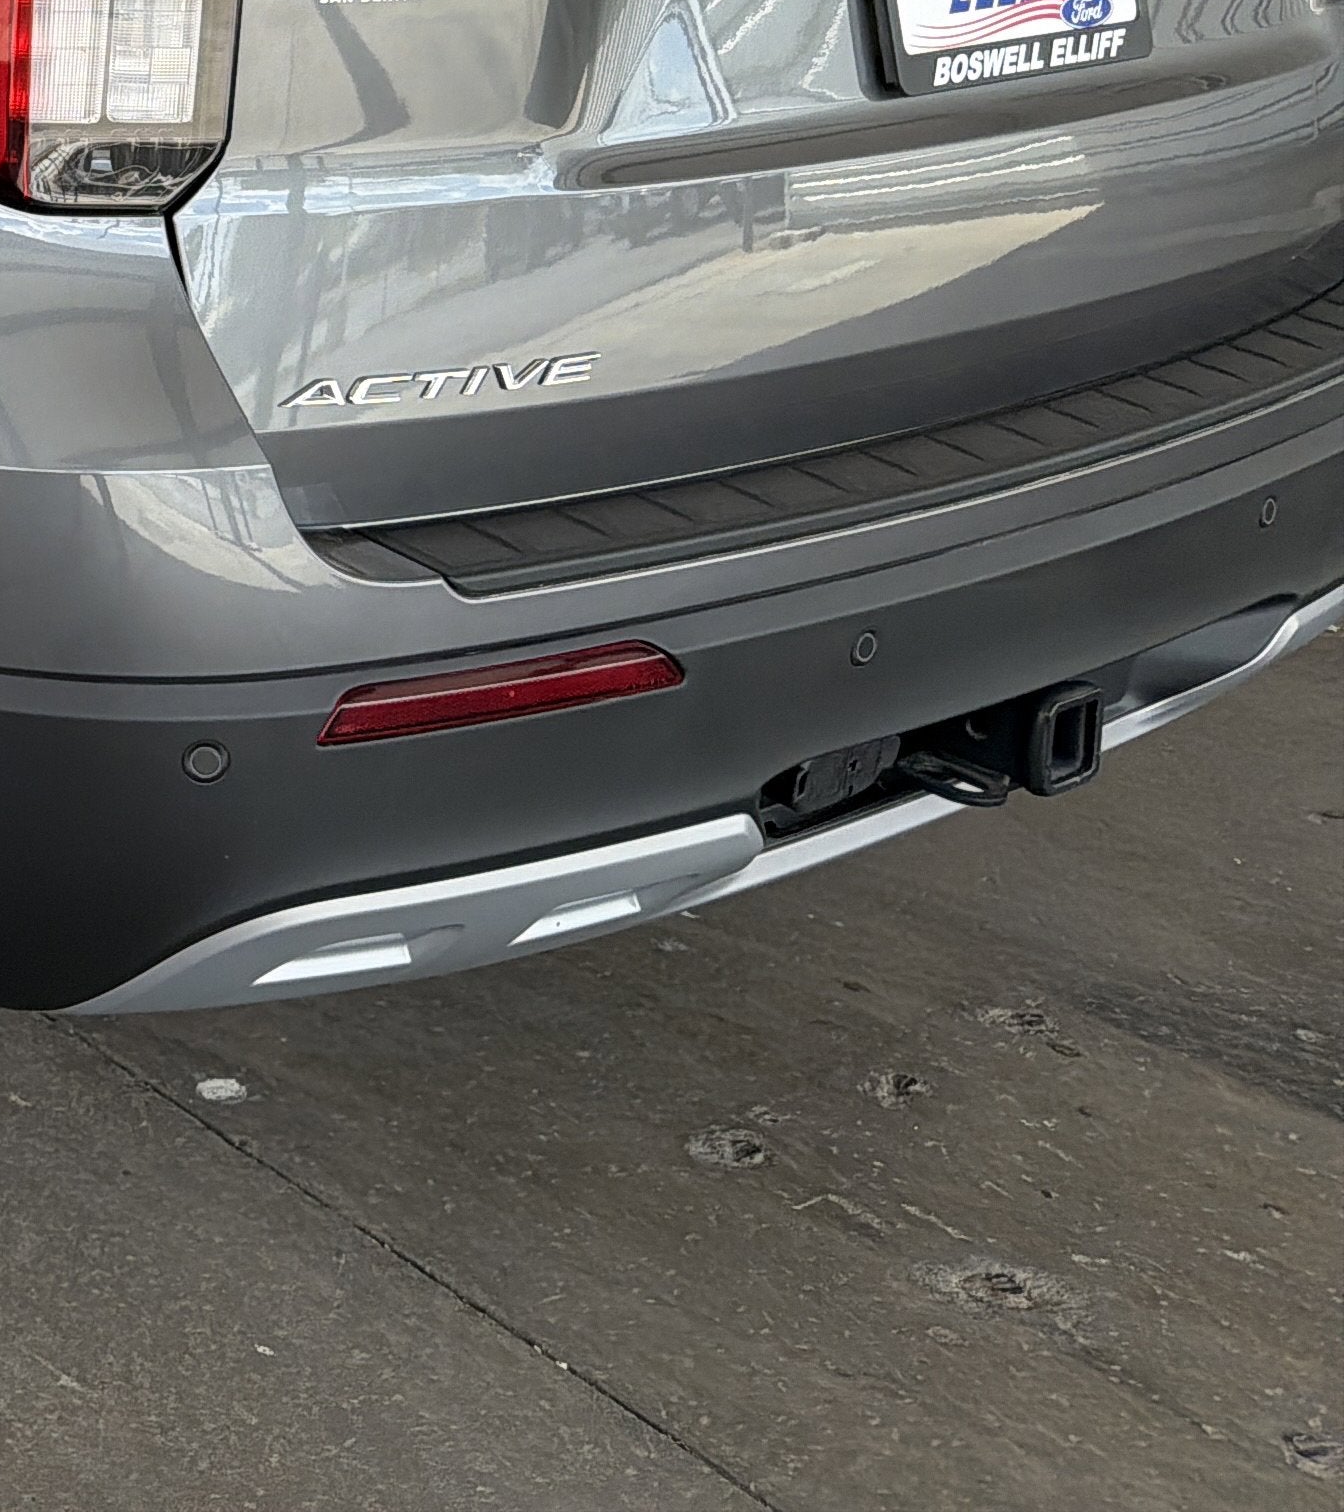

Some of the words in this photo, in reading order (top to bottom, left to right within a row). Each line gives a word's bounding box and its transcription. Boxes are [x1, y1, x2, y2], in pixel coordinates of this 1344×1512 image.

[933, 42, 1044, 87] BOSWELL
[1050, 28, 1126, 67] ELLIFF
[277, 351, 602, 407] ACTIVE
